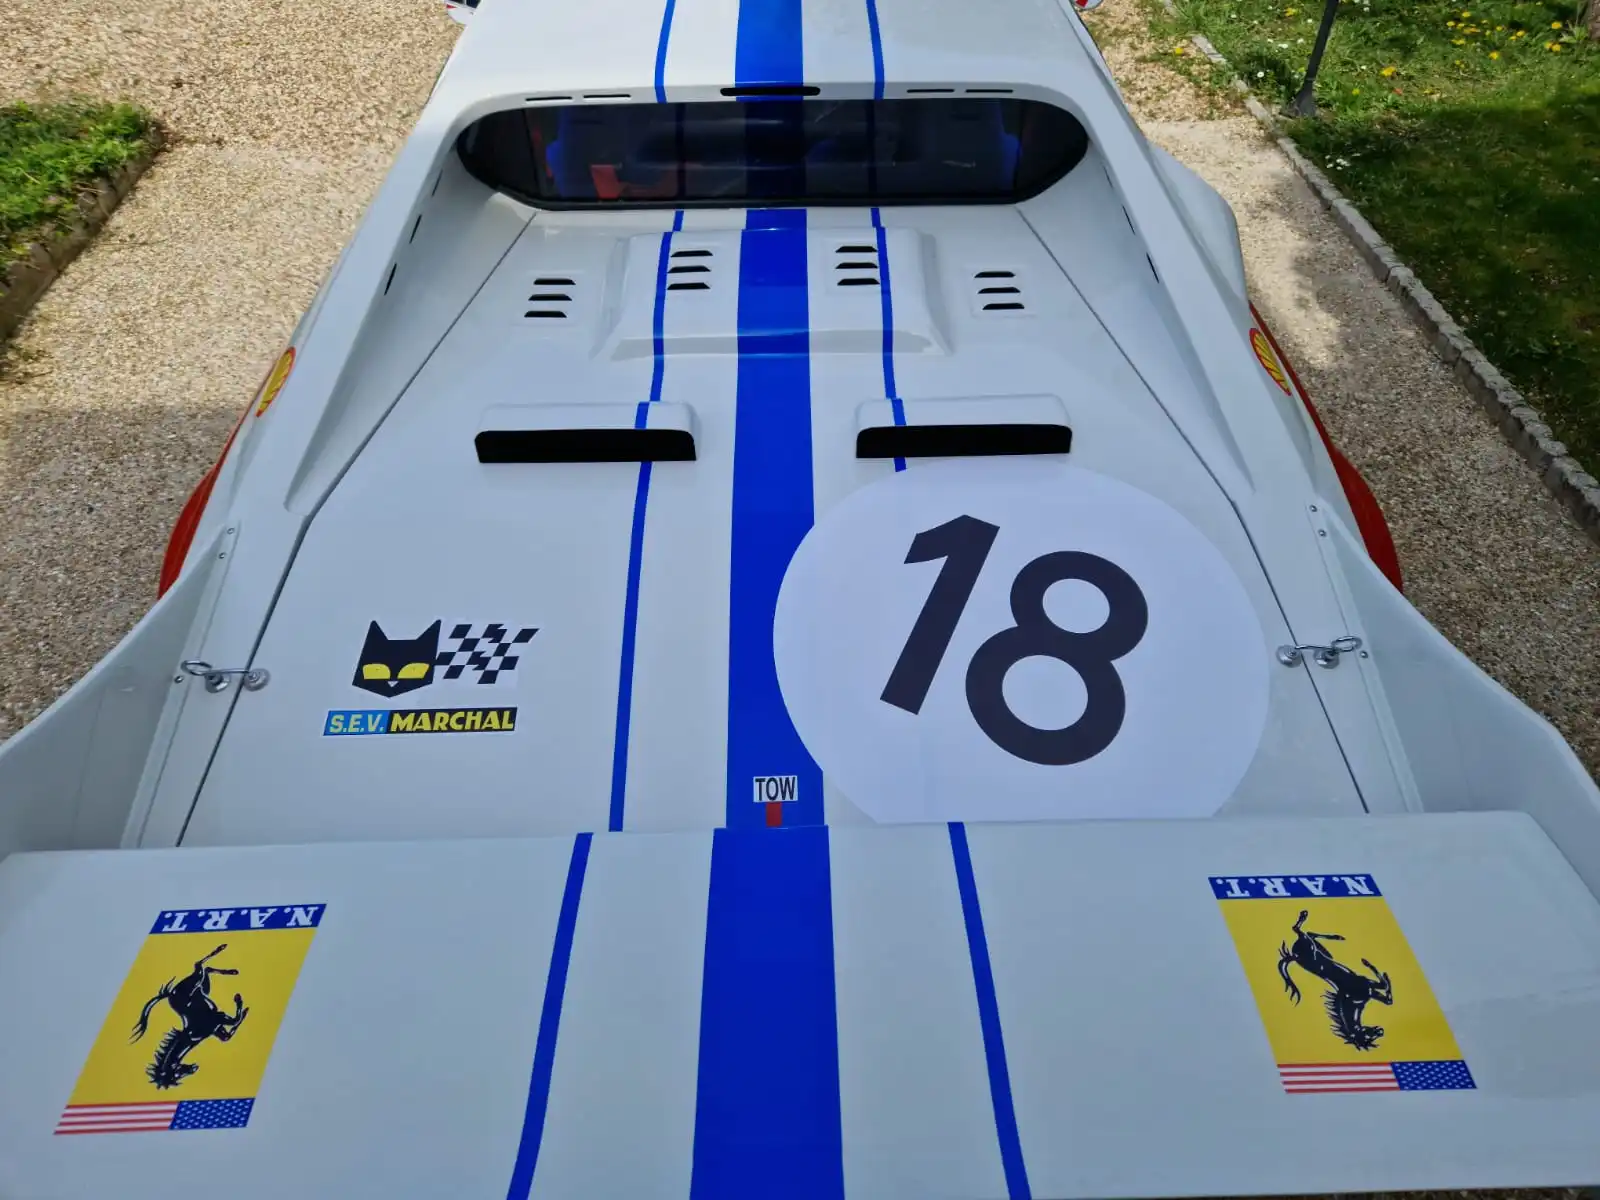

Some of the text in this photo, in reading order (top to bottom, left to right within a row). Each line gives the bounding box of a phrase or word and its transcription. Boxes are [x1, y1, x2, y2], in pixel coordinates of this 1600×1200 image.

[880, 514, 1148, 766] 18
[328, 710, 515, 733] S.E.V. MARCHAL
[755, 776, 796, 801] TOW
